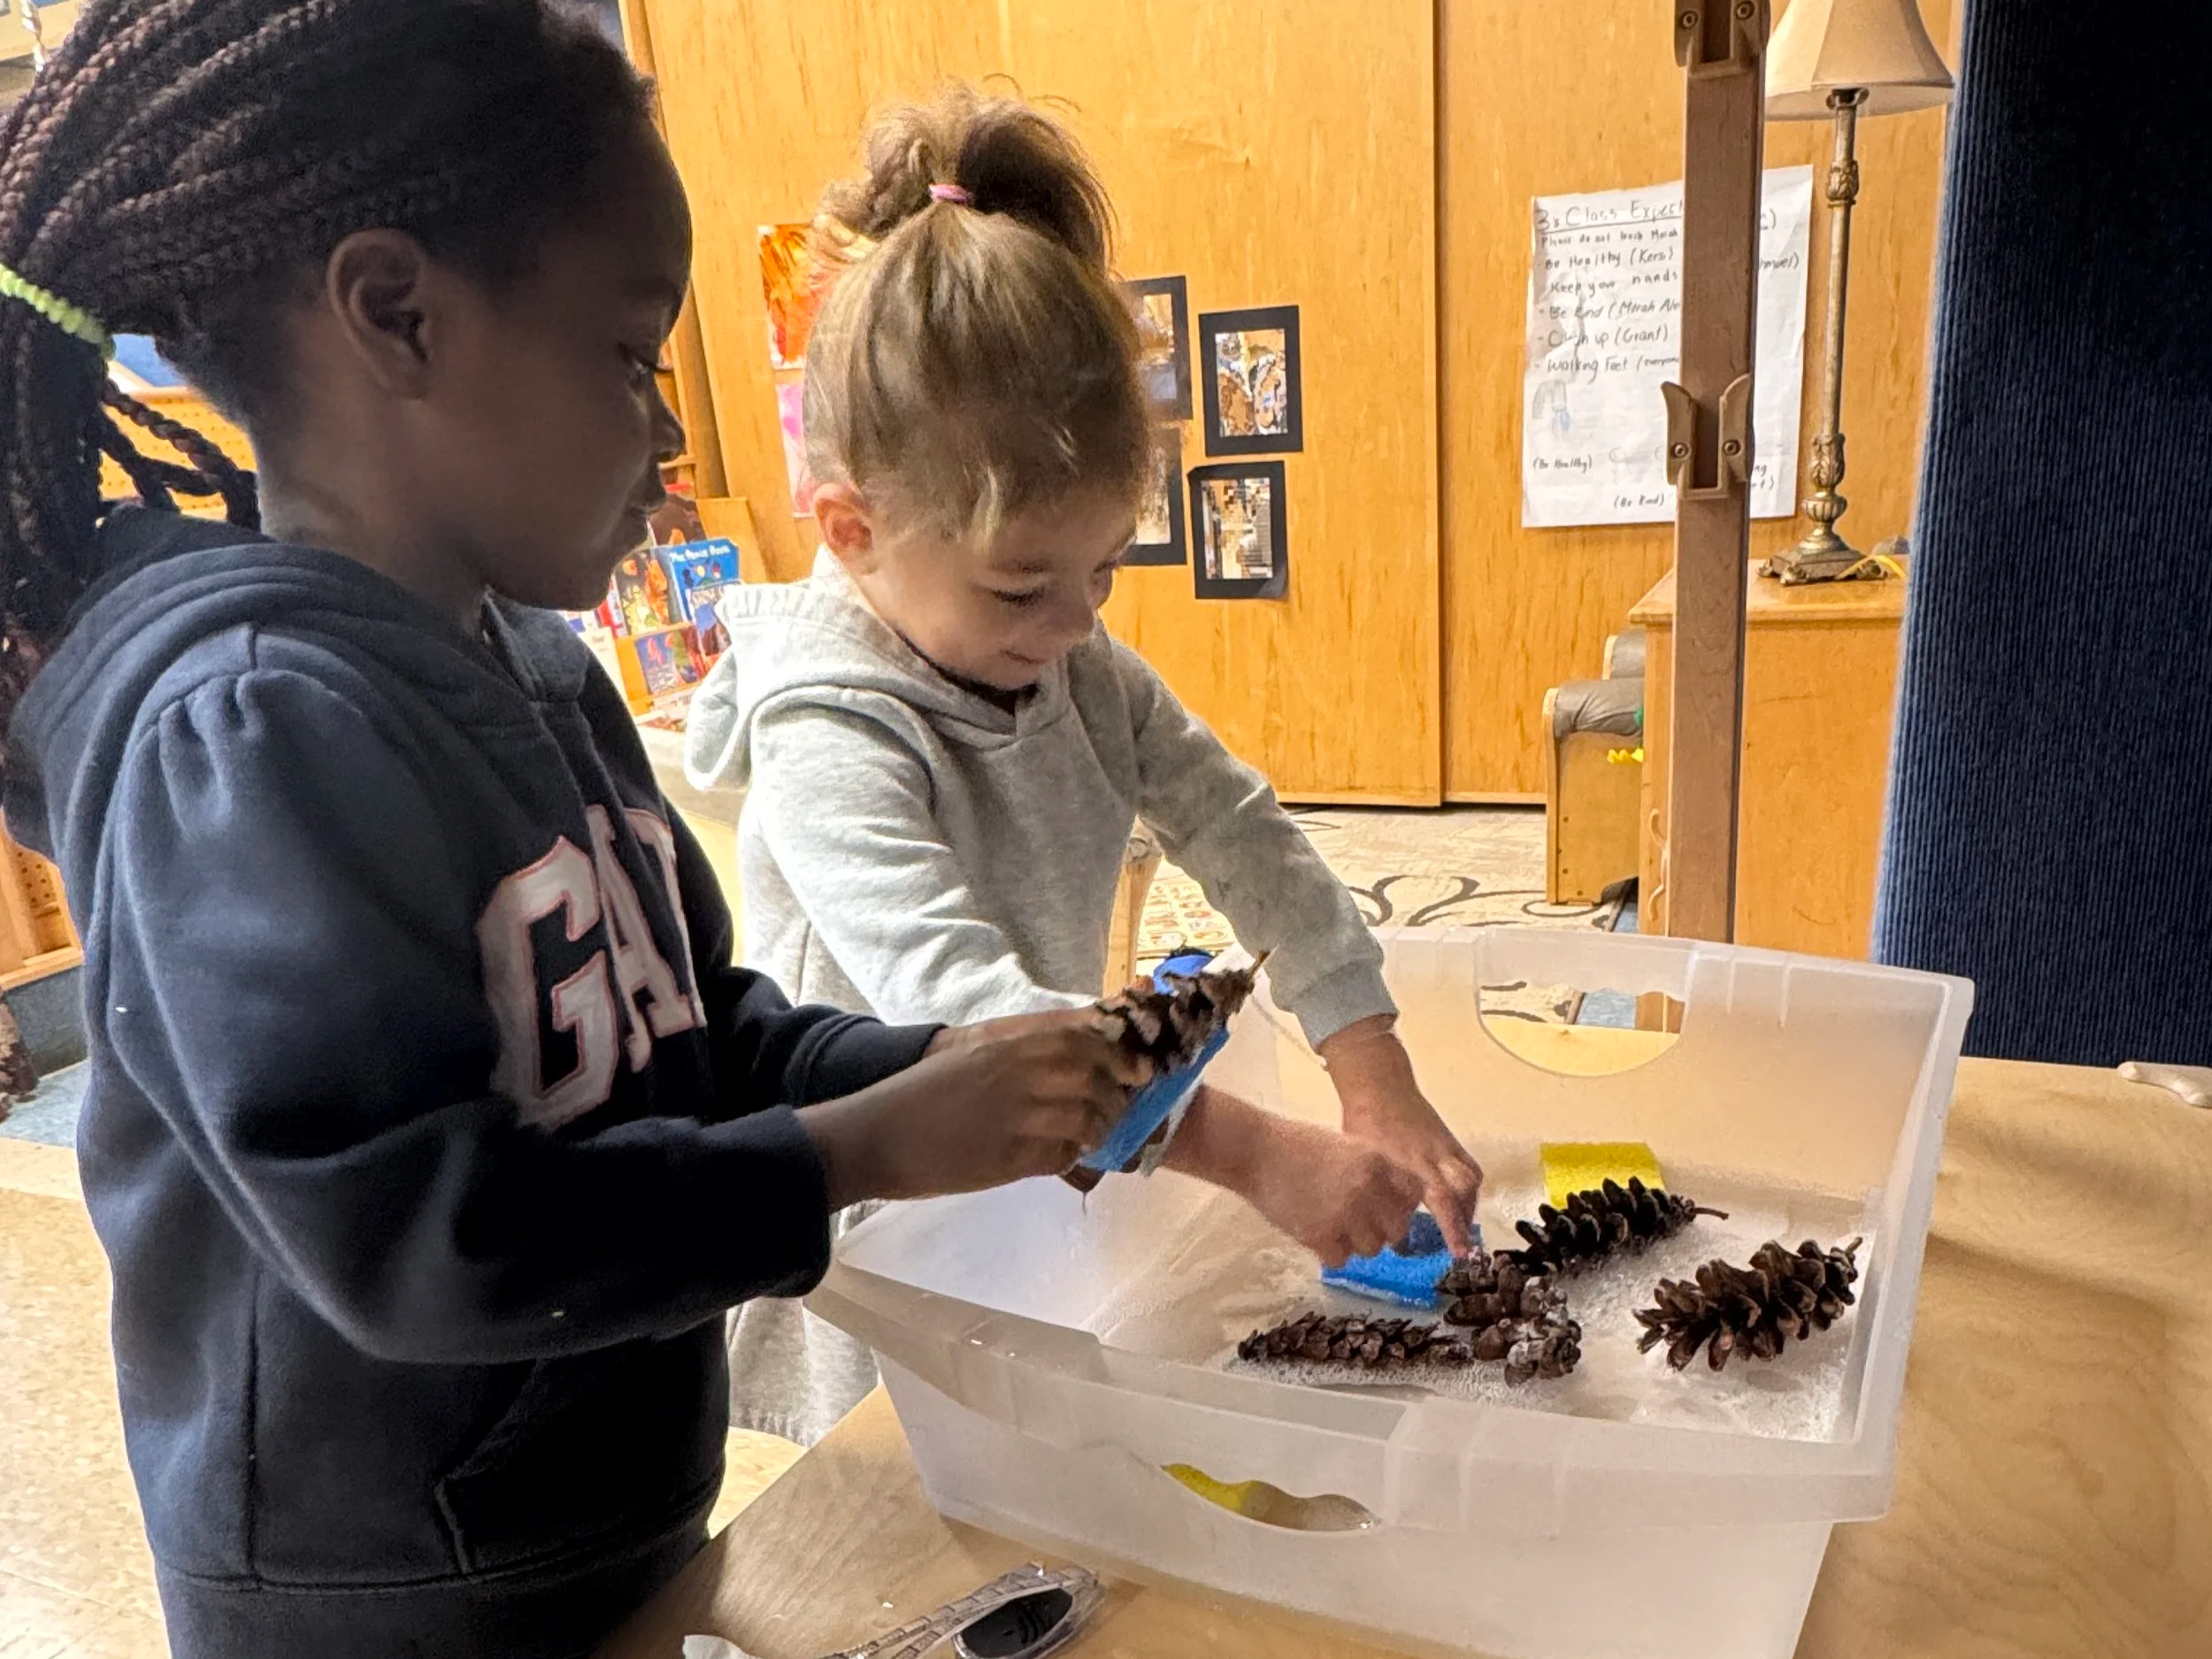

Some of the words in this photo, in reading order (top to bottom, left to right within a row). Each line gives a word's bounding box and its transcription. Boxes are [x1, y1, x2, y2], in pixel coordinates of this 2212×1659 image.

[1566, 206, 1617, 227] Class
[1579, 234, 1590, 242] do
[1545, 259, 1560, 270] Be
[1569, 251, 1621, 267] Healthy
[1550, 282, 1582, 296] Keep
[1588, 281, 1616, 297] your
[1549, 306, 1566, 319] Be
[1594, 333, 1609, 349] up
[1614, 324, 1668, 346] (Grant)
[1547, 357, 1599, 385] Walking
[1605, 356, 1628, 372] Feet
